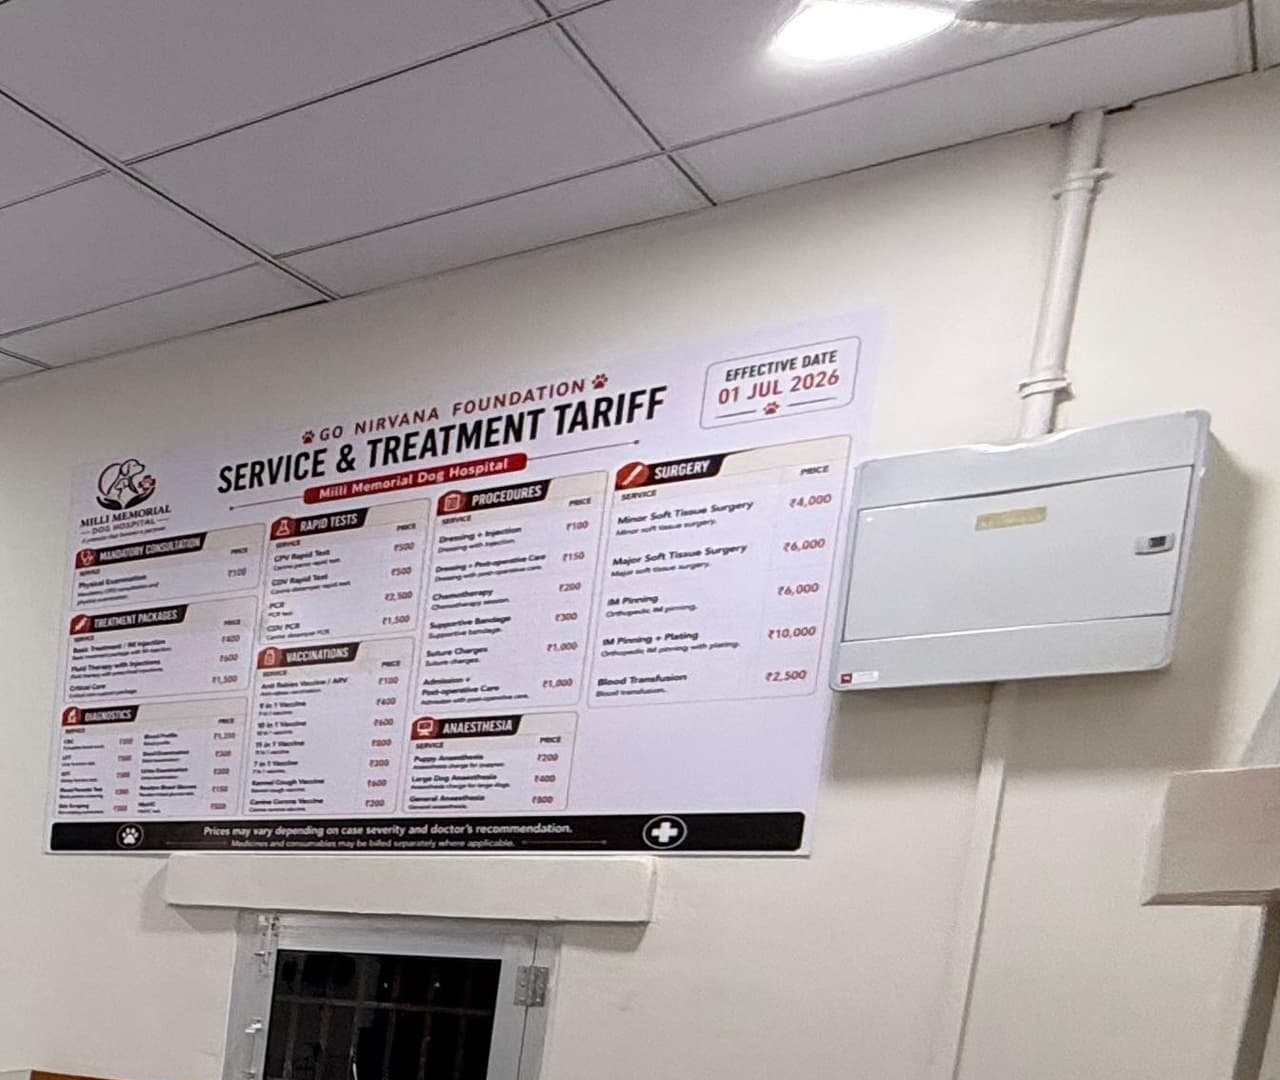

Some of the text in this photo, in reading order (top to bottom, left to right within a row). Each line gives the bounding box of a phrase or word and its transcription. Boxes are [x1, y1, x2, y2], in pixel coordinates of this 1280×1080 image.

[725, 350, 838, 382] EFFECTIVE DATE
[718, 368, 839, 404] 01 JUL 2026
[319, 379, 585, 441] GO NIRVANA FOUNDATION
[218, 386, 667, 494] SERVICE & TREATMENT TARIFF
[654, 460, 711, 479] SURGERY
[800, 465, 829, 476] PRICE
[319, 459, 507, 498] Milli Memorial Dog Hospital
[472, 485, 542, 506] PROCEDURES
[621, 490, 656, 500] SERVICE
[790, 494, 832, 508] ₹4,000
[81, 504, 172, 528] MILLI MEMORIAL
[618, 500, 754, 524] Minor Soft Tissue Surgery
[92, 519, 155, 534] DOG HOSPITAL
[300, 513, 358, 532] RAPID TESTS
[616, 528, 639, 536] Minor
[641, 525, 656, 533] soft
[439, 533, 475, 543] Dressing
[783, 539, 825, 552] ₹6,000
[291, 552, 312, 561] Rapid
[612, 544, 747, 567] Major Soft Tissue Surgery
[290, 576, 311, 584] Rapid
[611, 569, 633, 577] Major
[432, 589, 493, 601] Chemotherapy
[778, 583, 819, 596] ₹6,000
[623, 595, 658, 606] Pinning
[95, 609, 178, 629] TREATMENT PACKAGES
[430, 616, 511, 629] Supportive Bandage
[603, 638, 615, 646] IM
[617, 635, 652, 646] Pinning
[665, 631, 698, 642] Plating
[769, 627, 816, 639] ₹10,000
[286, 648, 349, 662] VACCINATIONS
[455, 647, 488, 656] Charges
[598, 674, 687, 686] Blood Transfusion
[766, 670, 806, 682] ₹2,500
[443, 720, 512, 734] ANAESTHESIA
[203, 823, 573, 839] Prices may vary depending on case severity and doctor's recommendation.
[339, 841, 354, 849] may
[394, 840, 436, 849] separately
[467, 839, 515, 848] applicable.
